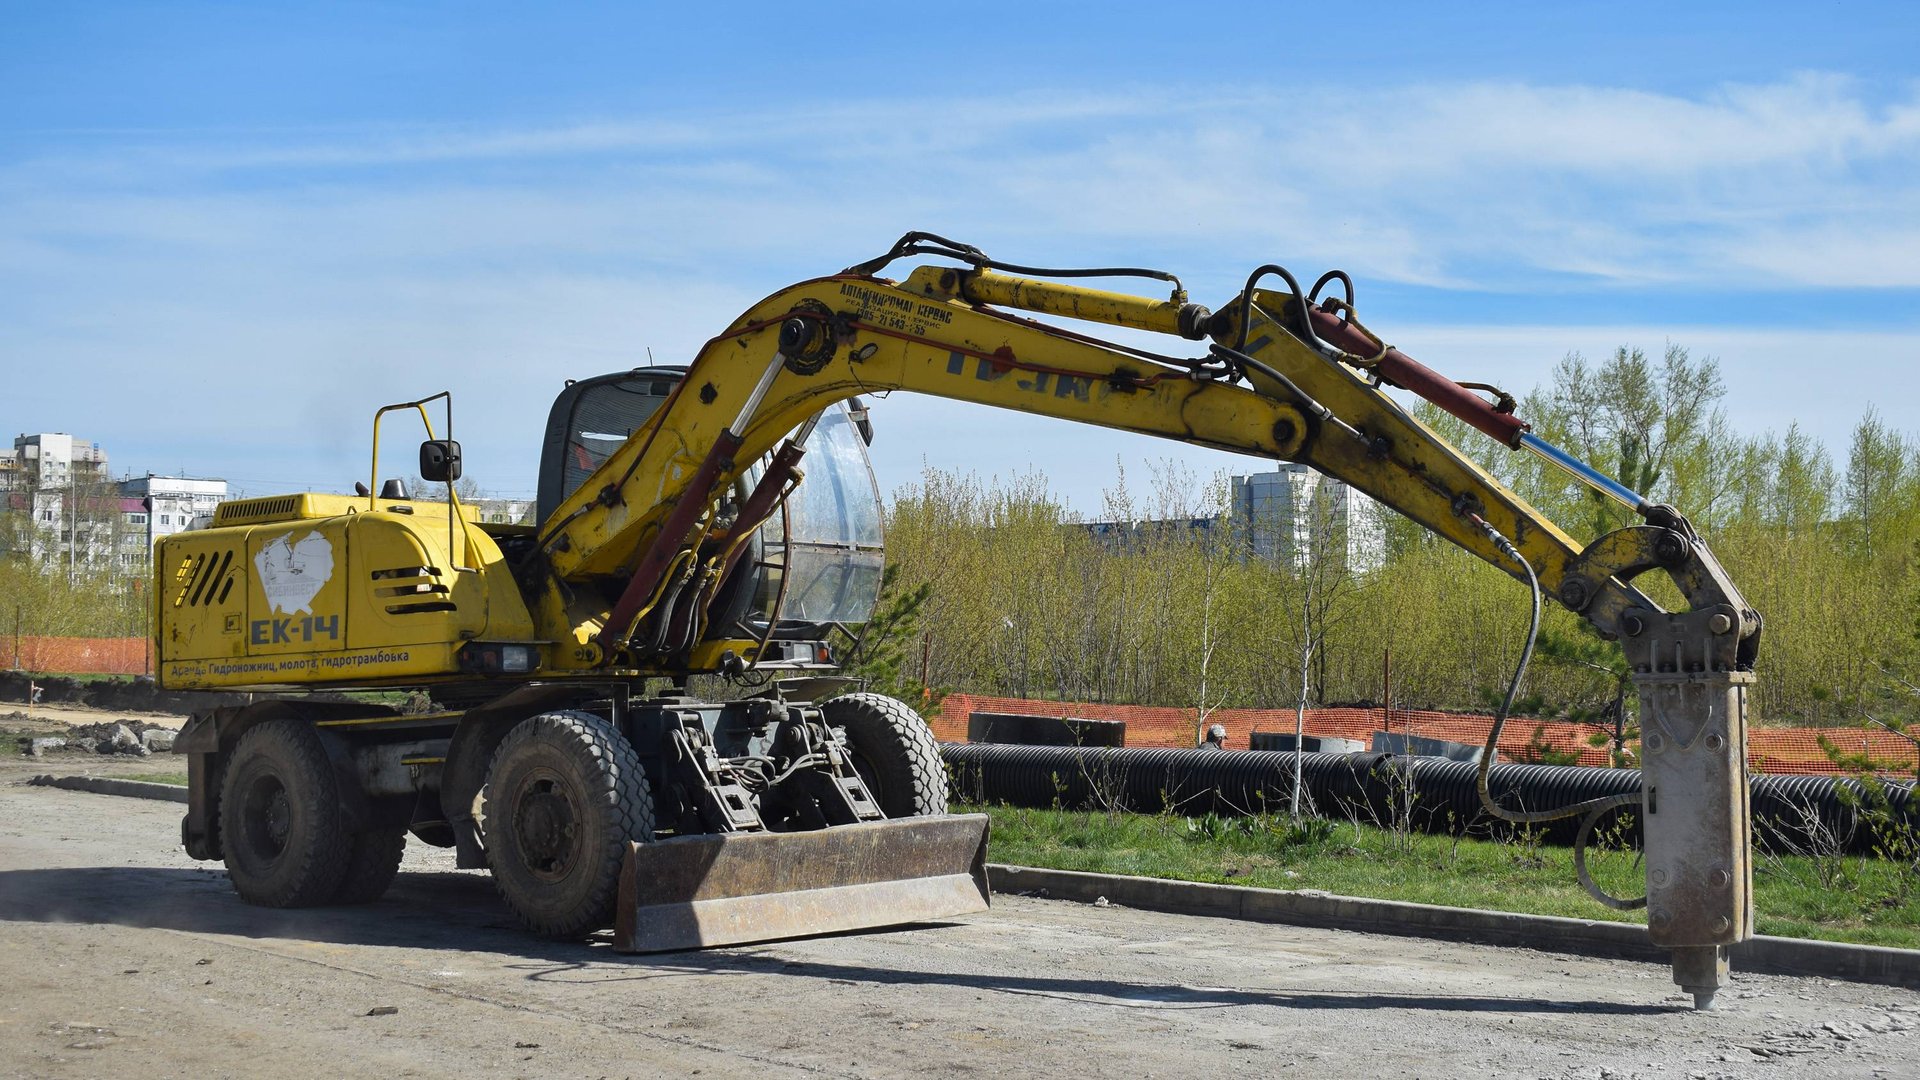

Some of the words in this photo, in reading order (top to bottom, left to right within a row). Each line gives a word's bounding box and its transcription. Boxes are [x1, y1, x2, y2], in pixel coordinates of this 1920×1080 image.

[208, 661, 278, 675] Гидроножниц,
[280, 658, 319, 670] молота,
[321, 651, 409, 668] гидротрамбовка
